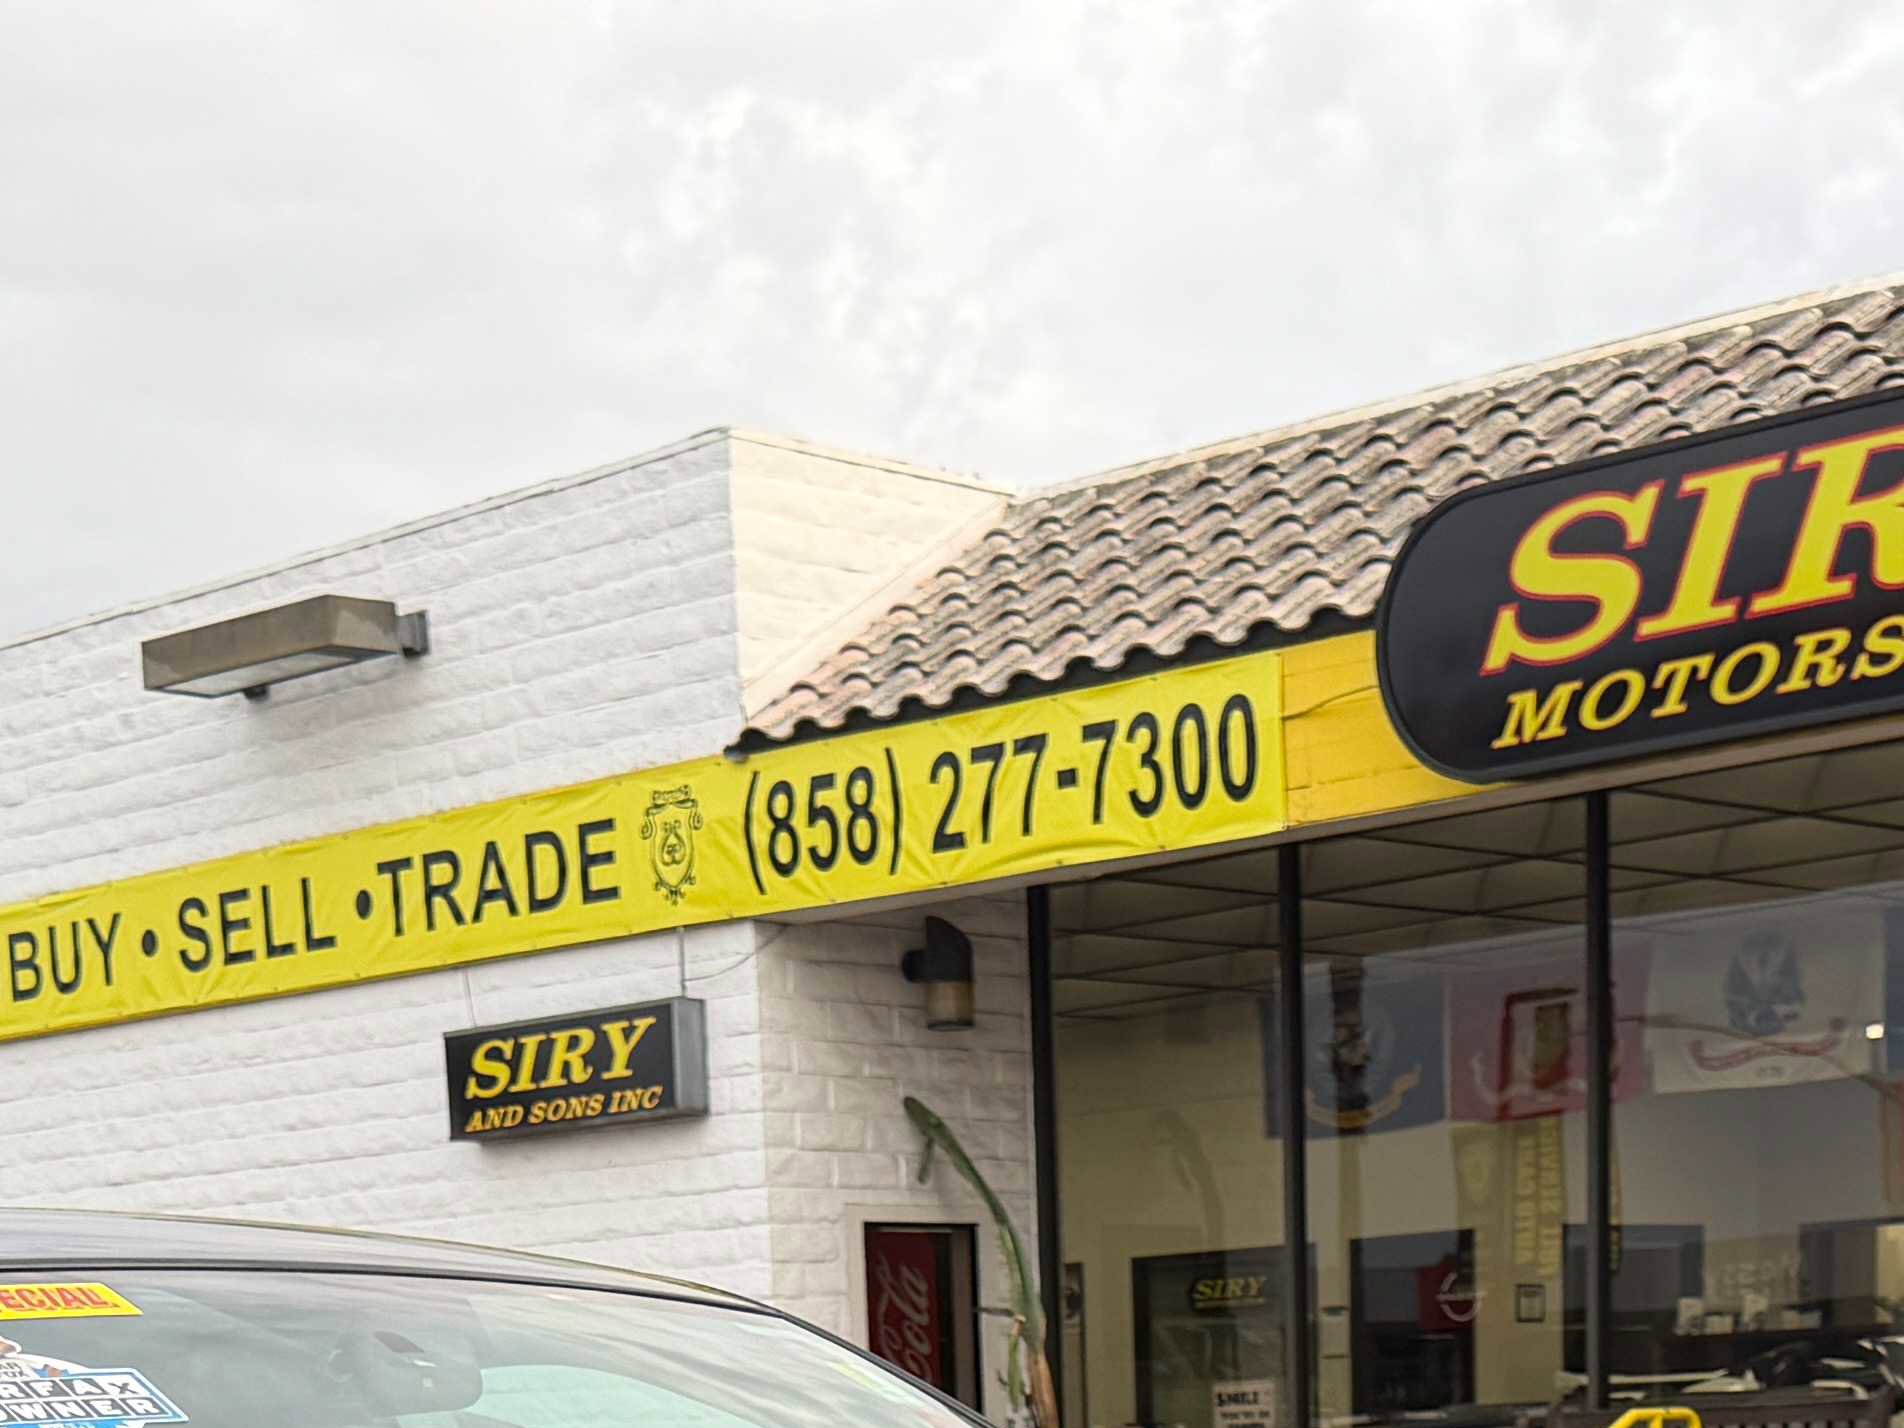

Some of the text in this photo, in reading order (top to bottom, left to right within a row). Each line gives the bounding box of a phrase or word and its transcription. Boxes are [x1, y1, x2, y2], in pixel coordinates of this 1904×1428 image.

[743, 692, 1259, 896] (858) 277-7300
[7, 817, 623, 1004] BUY SELL TRADE
[464, 1016, 658, 1101] SIRY
[465, 1083, 664, 1134] AND SONS INC
